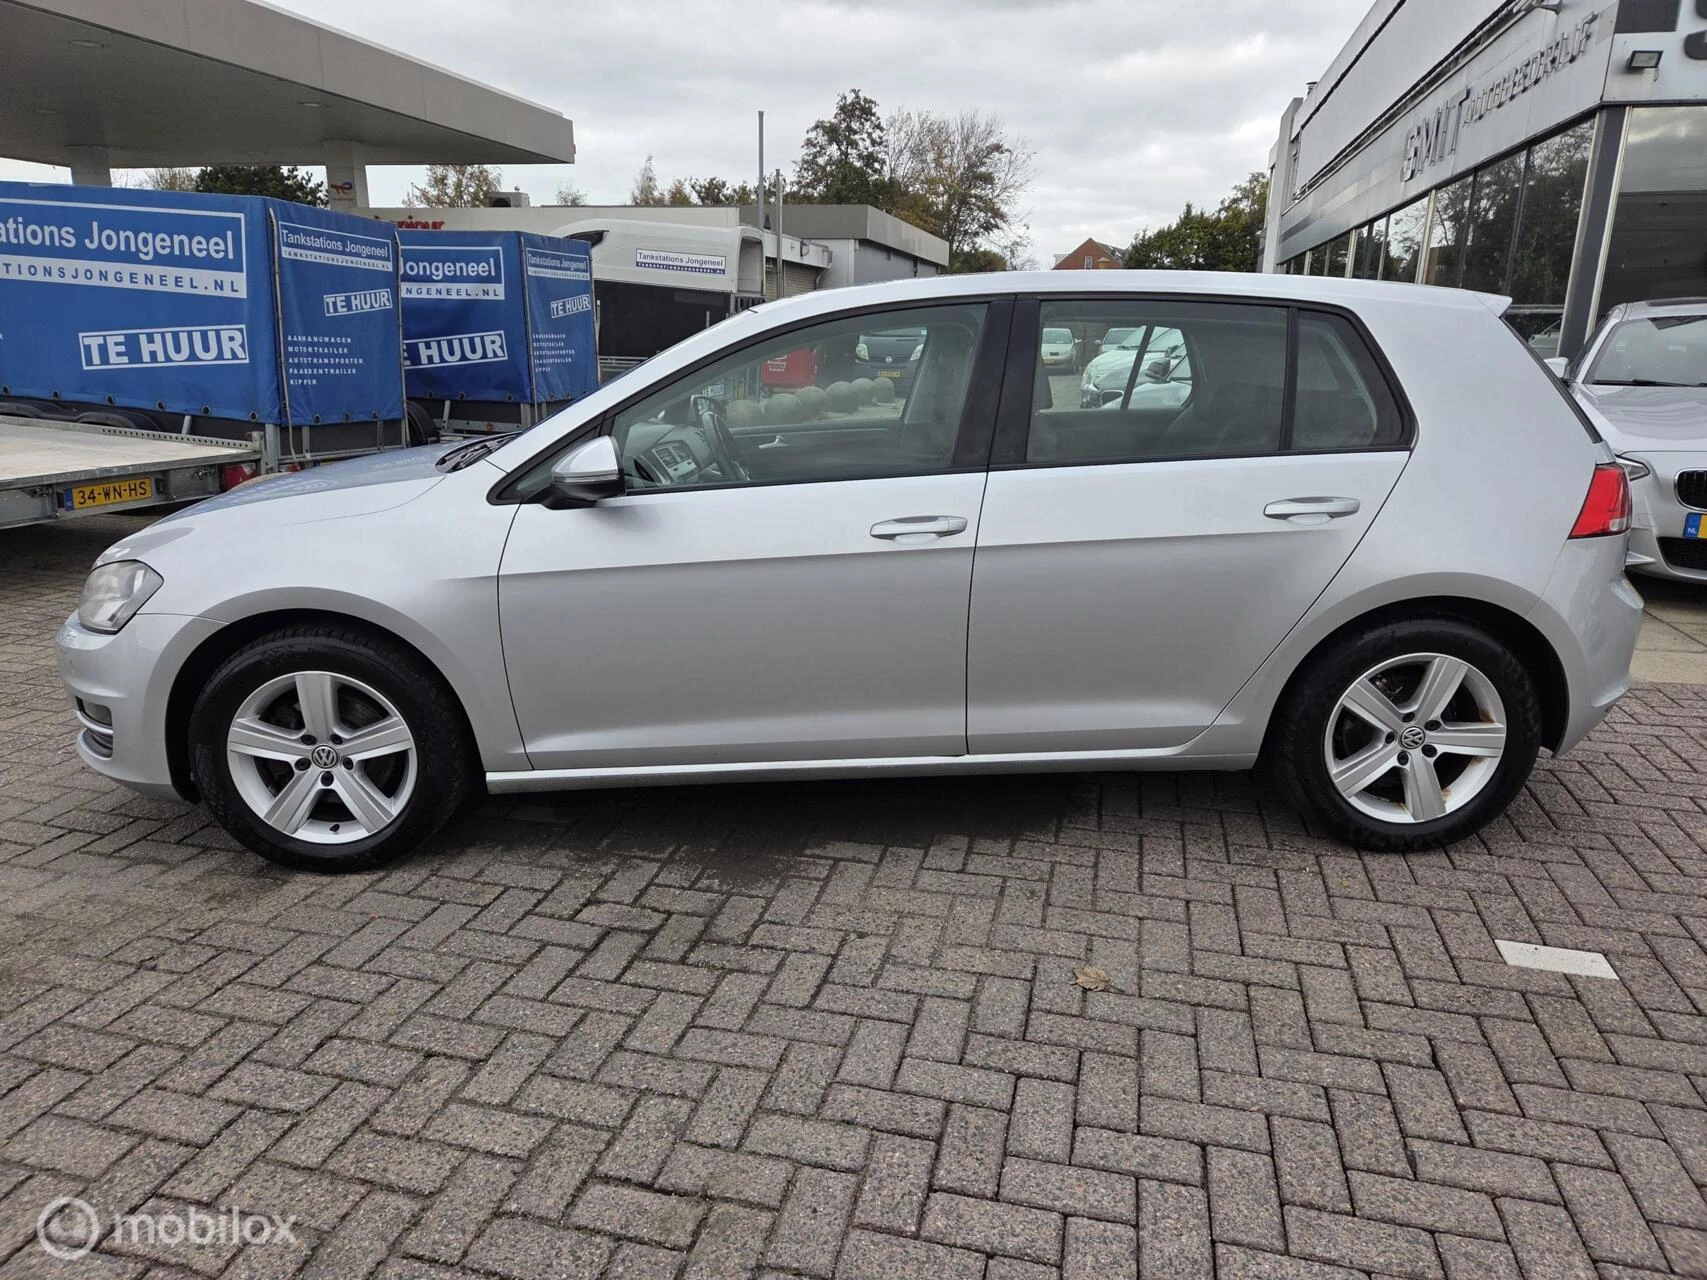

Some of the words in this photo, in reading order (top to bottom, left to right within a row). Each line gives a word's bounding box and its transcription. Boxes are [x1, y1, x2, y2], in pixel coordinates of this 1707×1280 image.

[1400, 87, 1471, 183] SMIT
[85, 221, 234, 260] Jongeneel
[281, 229, 343, 251] Tankstations
[345, 240, 388, 257] Jongeneel
[638, 252, 684, 264] Tankstations
[685, 257, 723, 267] Jongeneel
[3, 263, 239, 292] TIONSJONGENEEL.NL
[325, 296, 347, 313] TE
[351, 291, 391, 311] HUUR
[552, 302, 564, 316] TE
[565, 296, 590, 313] HUUR
[82, 335, 129, 365] TE
[139, 329, 247, 363] HUUR
[418, 334, 505, 365] HUUR
[78, 481, 147, 505] 34-WN-HS
